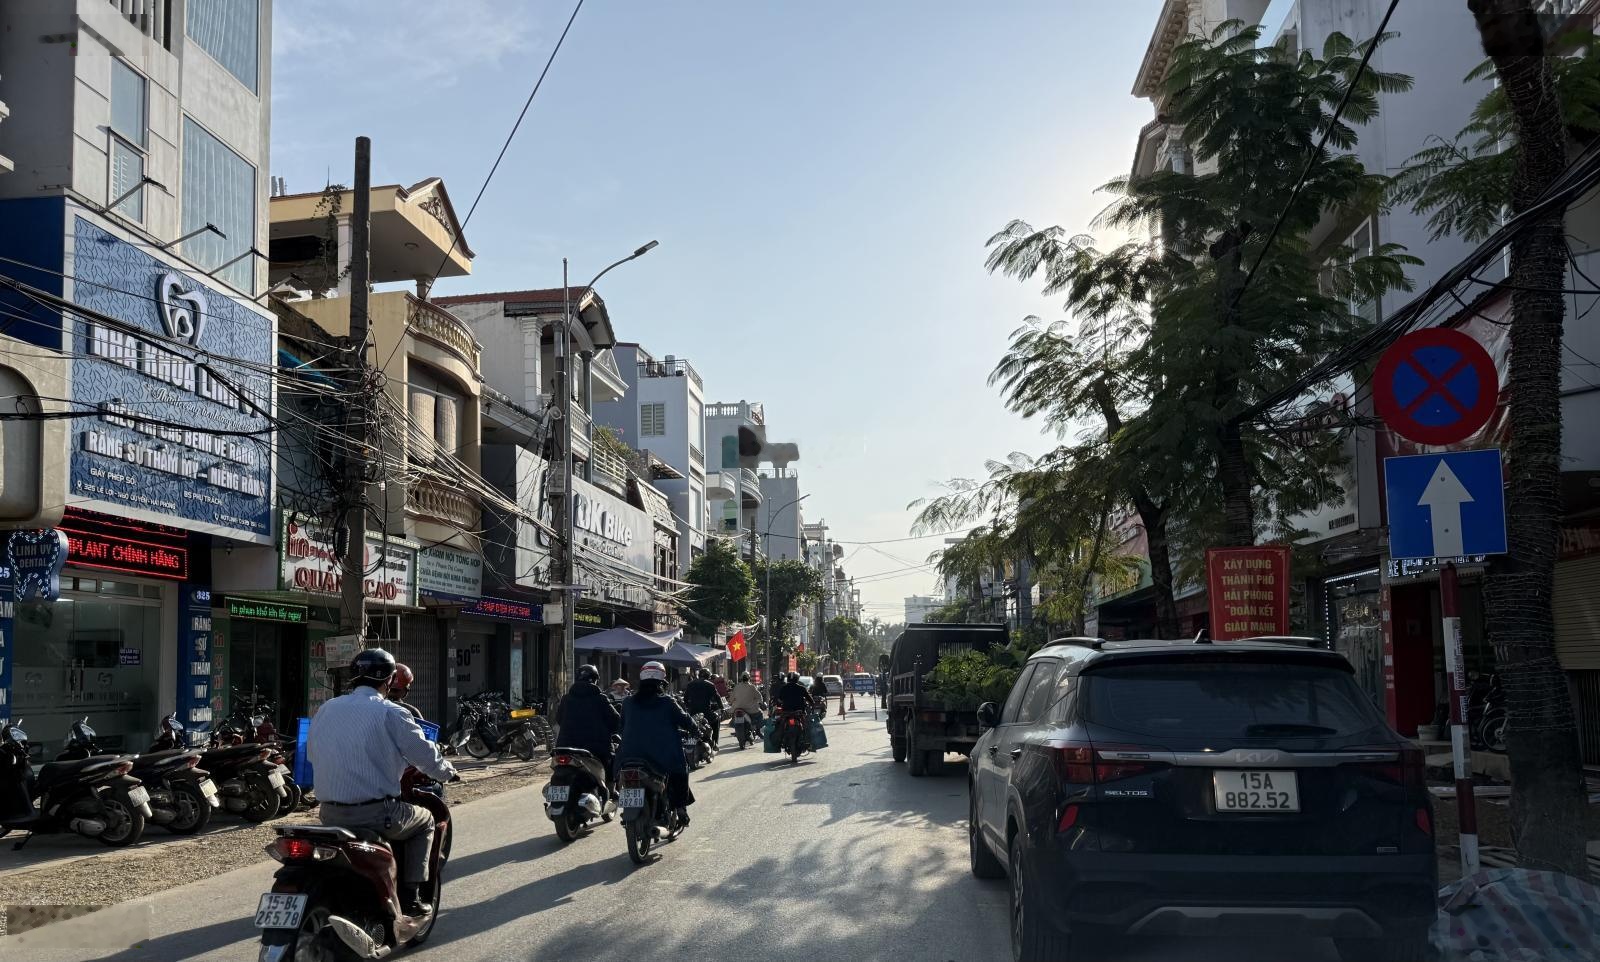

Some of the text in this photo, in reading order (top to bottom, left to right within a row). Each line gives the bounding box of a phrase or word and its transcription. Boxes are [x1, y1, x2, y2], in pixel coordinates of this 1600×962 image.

[112, 543, 149, 566] CHÍNH
[1223, 558, 1272, 571] XÂY DỰNG
[1221, 571, 1275, 586] THÀNH PHỐ
[1259, 602, 1274, 617] KẾT
[1233, 751, 1279, 763] KIA
[1240, 773, 1273, 790] 15A
[1226, 792, 1293, 809] 882.52
[267, 896, 298, 910] 15-B4
[256, 911, 299, 927] 265.78
